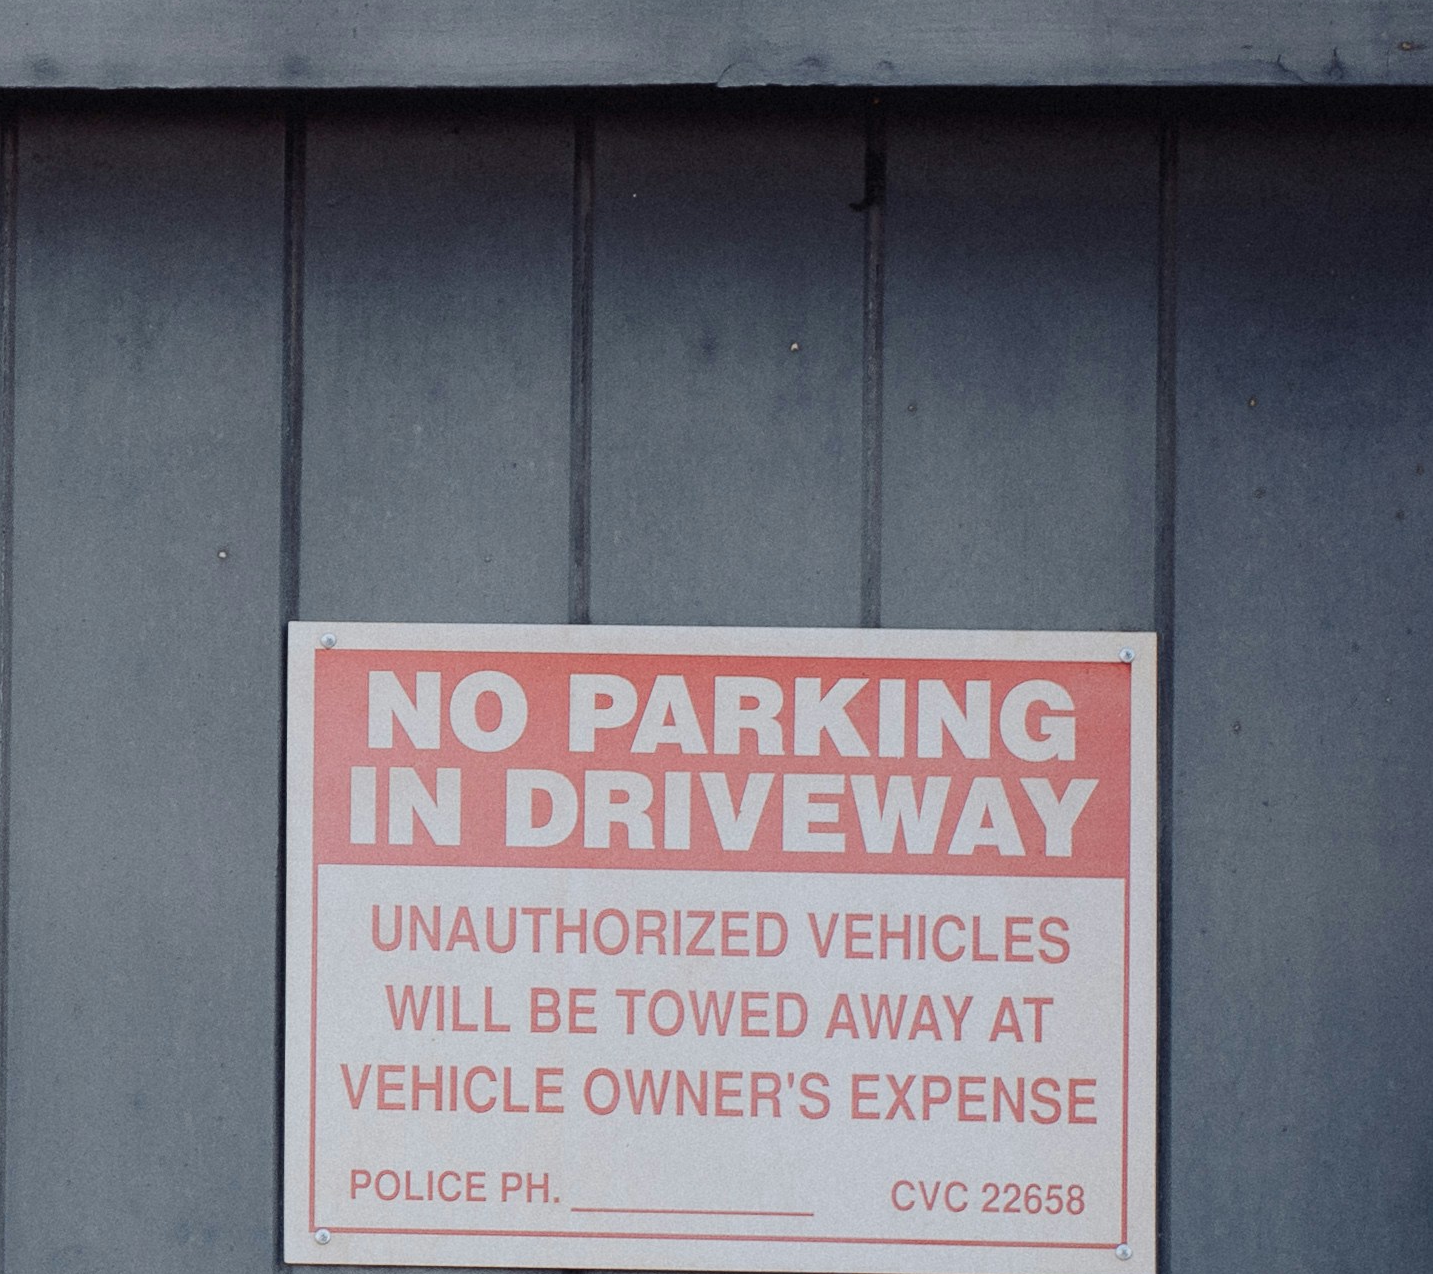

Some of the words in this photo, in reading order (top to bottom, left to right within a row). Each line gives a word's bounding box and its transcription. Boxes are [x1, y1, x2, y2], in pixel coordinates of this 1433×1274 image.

[365, 669, 530, 755] NO
[567, 672, 1077, 764] PARKING
[346, 763, 464, 849] IN
[503, 766, 1099, 859] DRIVEWAY
[371, 905, 789, 958] UNAUTHORIZED
[808, 912, 1071, 965] VEHICLES
[385, 985, 511, 1033] WILL
[529, 987, 597, 1035] BE
[615, 988, 809, 1039] TOWED
[825, 992, 973, 1041] AWAY
[989, 996, 1054, 1043] AT
[340, 1064, 565, 1114] VEHICLE
[582, 1068, 831, 1121] OWNER'S
[850, 1073, 1098, 1126] EXPENSE
[349, 1169, 487, 1203] POLICE
[500, 1172, 562, 1204] PH.
[890, 1180, 969, 1213] CVC
[981, 1182, 1086, 1216] 22658
